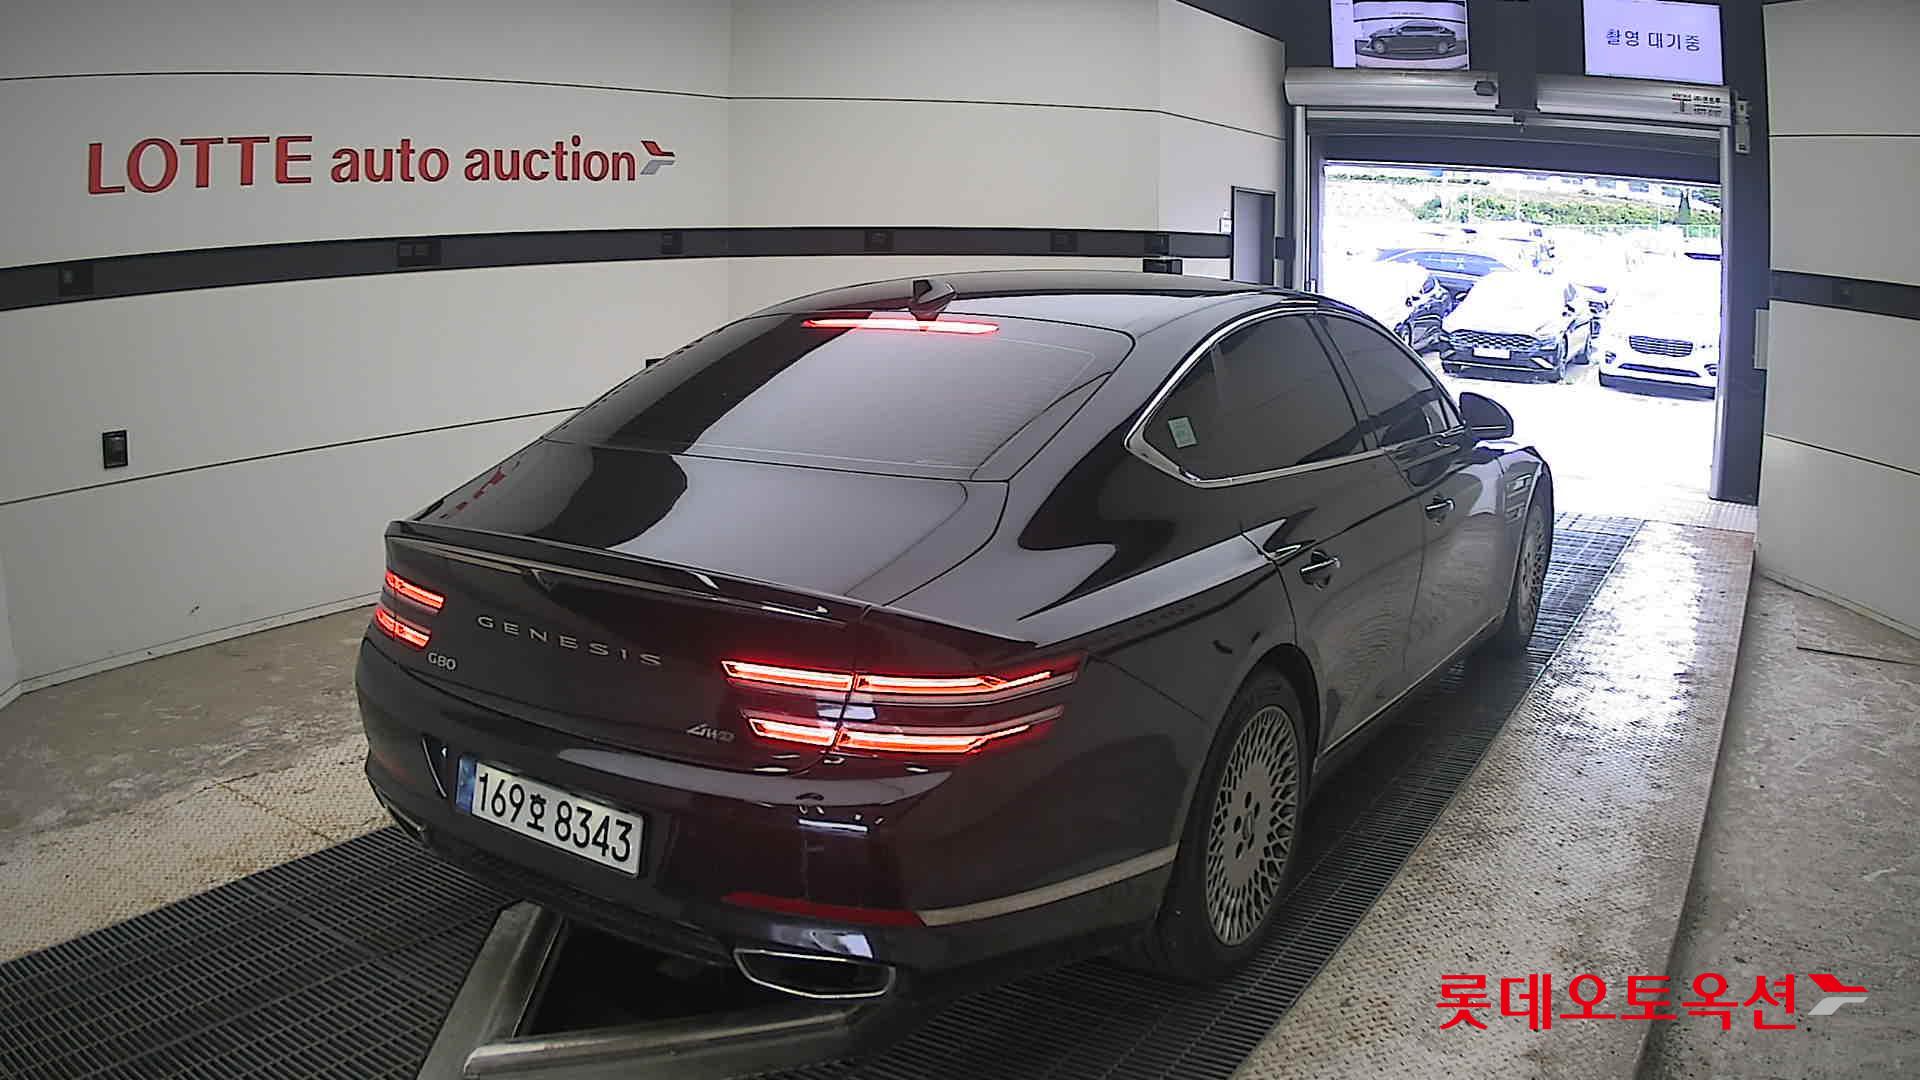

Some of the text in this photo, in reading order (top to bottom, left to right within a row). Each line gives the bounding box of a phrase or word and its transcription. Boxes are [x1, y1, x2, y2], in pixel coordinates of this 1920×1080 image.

[1606, 29, 1700, 52] 촬영 대기중
[87, 135, 637, 195] LOTTE auto auction
[427, 651, 457, 671] G80
[477, 615, 662, 666] GENESIS
[478, 772, 633, 863] 169호 8343
